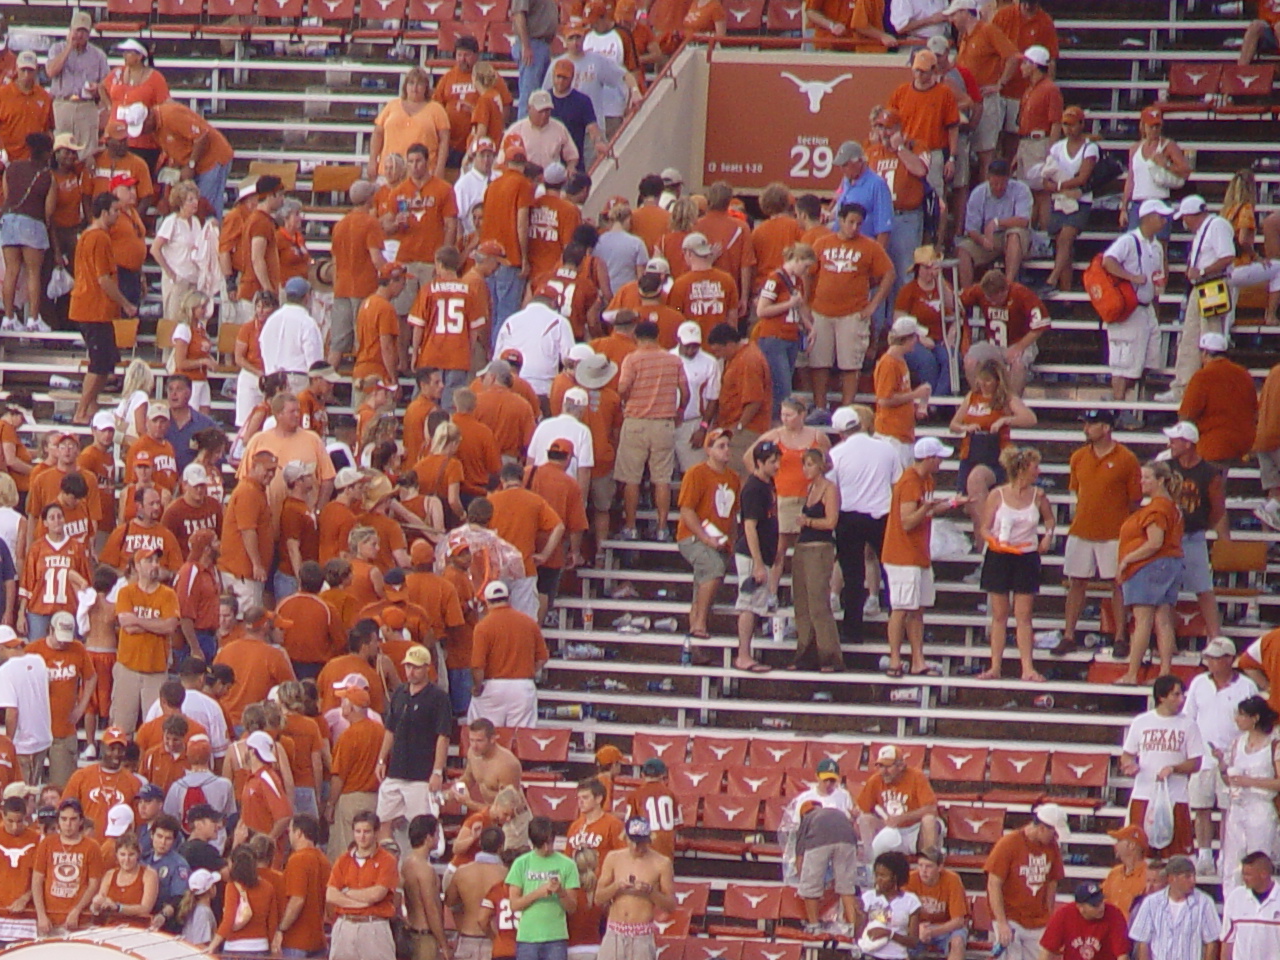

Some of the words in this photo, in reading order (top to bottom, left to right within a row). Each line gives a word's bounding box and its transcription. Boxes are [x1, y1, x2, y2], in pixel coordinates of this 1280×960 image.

[451, 84, 477, 94] TEXA
[789, 146, 833, 178] 29
[876, 159, 898, 170] TEXAS
[823, 247, 861, 263] TEXAS
[434, 298, 466, 334] 15
[124, 535, 163, 553] TEXAS
[44, 555, 71, 569] TEXAS
[43, 568, 67, 604] 11
[1141, 729, 1186, 744] TEXAS
[644, 796, 674, 831] 10
[569, 831, 602, 849] TEXAS
[52, 851, 84, 866] TEXAS
